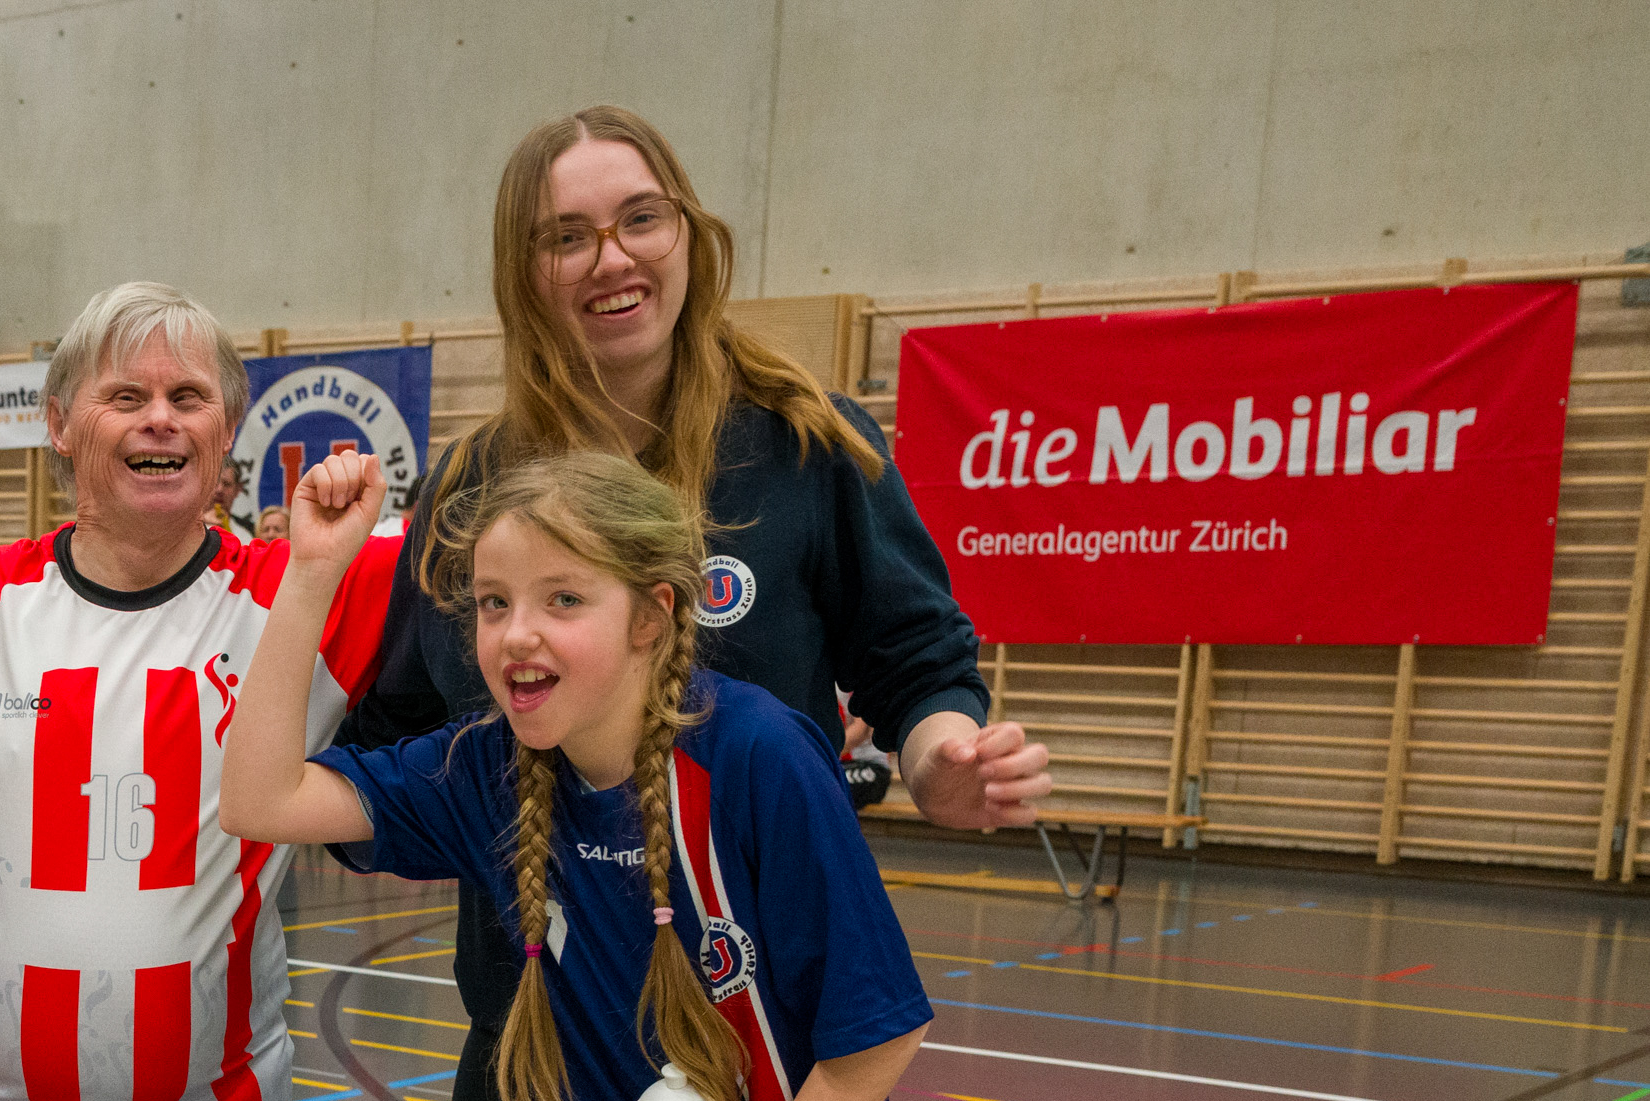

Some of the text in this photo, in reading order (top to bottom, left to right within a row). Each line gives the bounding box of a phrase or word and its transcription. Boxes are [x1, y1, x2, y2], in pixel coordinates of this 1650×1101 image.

[261, 375, 381, 429] Handball
[959, 391, 1477, 490] die Mobiliar
[957, 518, 1288, 561] Generalagentur Zürich
[80, 772, 156, 862] 16
